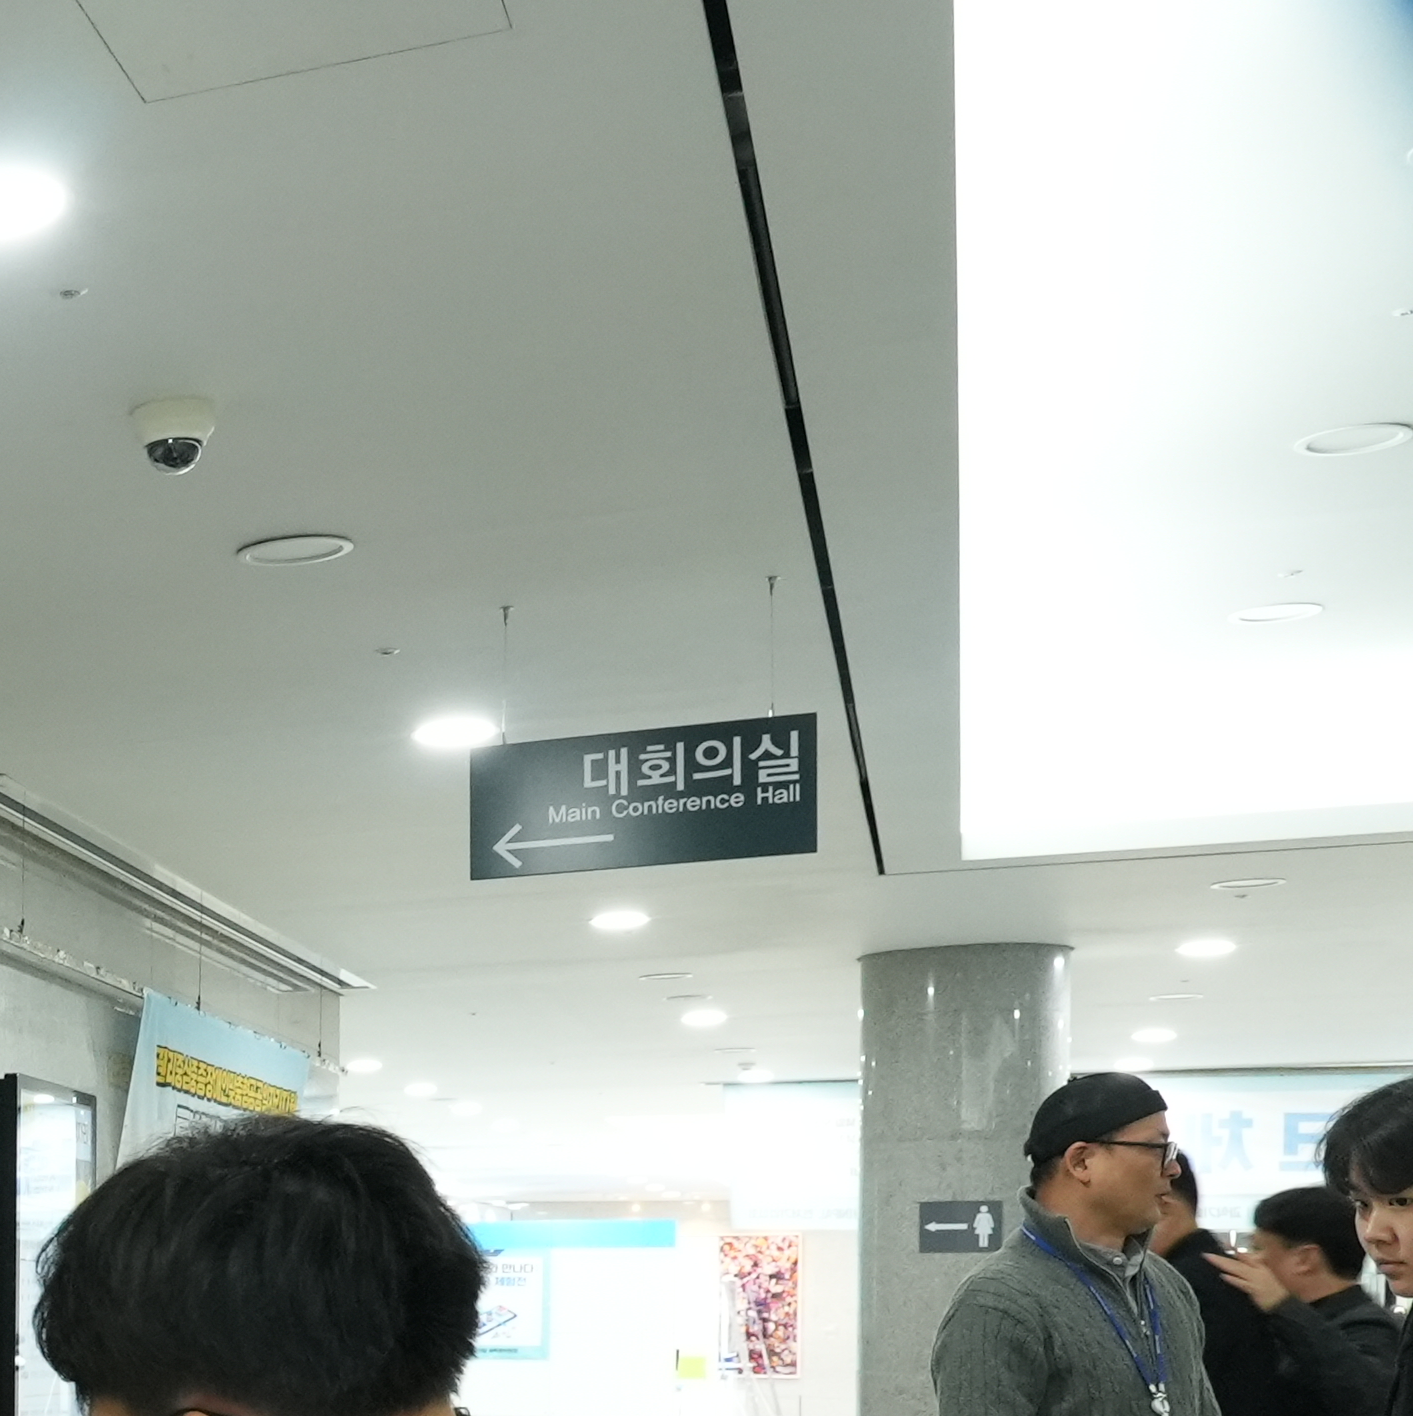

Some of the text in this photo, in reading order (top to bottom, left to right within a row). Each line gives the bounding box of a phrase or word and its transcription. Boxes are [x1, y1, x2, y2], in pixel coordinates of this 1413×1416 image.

[582, 730, 800, 796] 대회의실
[549, 784, 800, 824] Main Conference Hall
